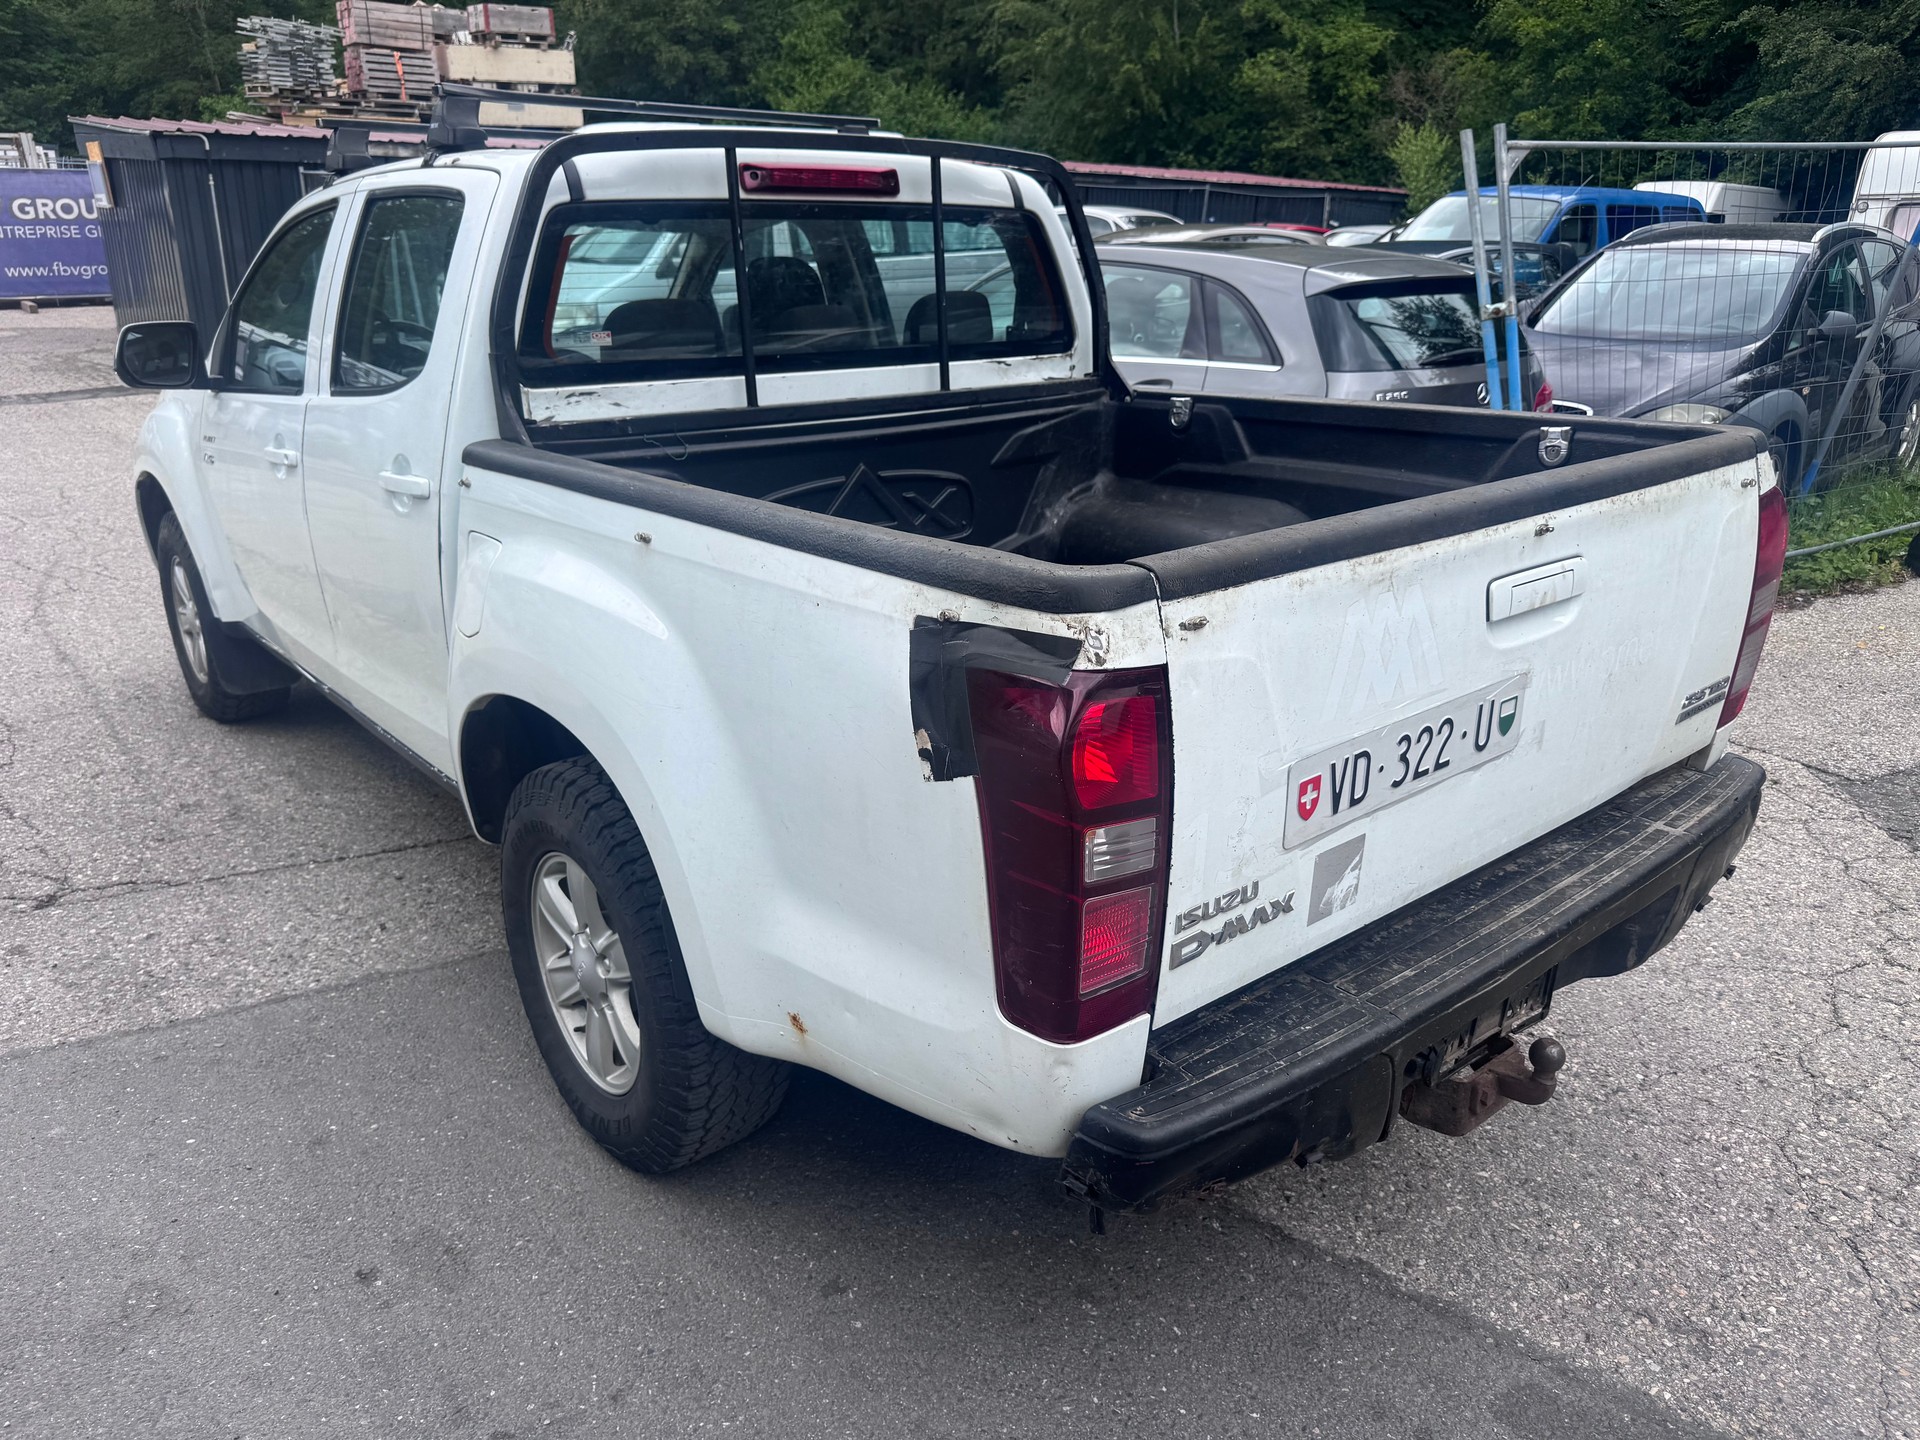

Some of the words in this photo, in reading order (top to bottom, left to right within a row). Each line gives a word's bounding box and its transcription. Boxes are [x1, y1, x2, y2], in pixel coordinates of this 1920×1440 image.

[5, 261, 108, 279] www.fbvgro
[1169, 889, 1295, 971] D-MAX
[1175, 880, 1259, 935] ISUZU
